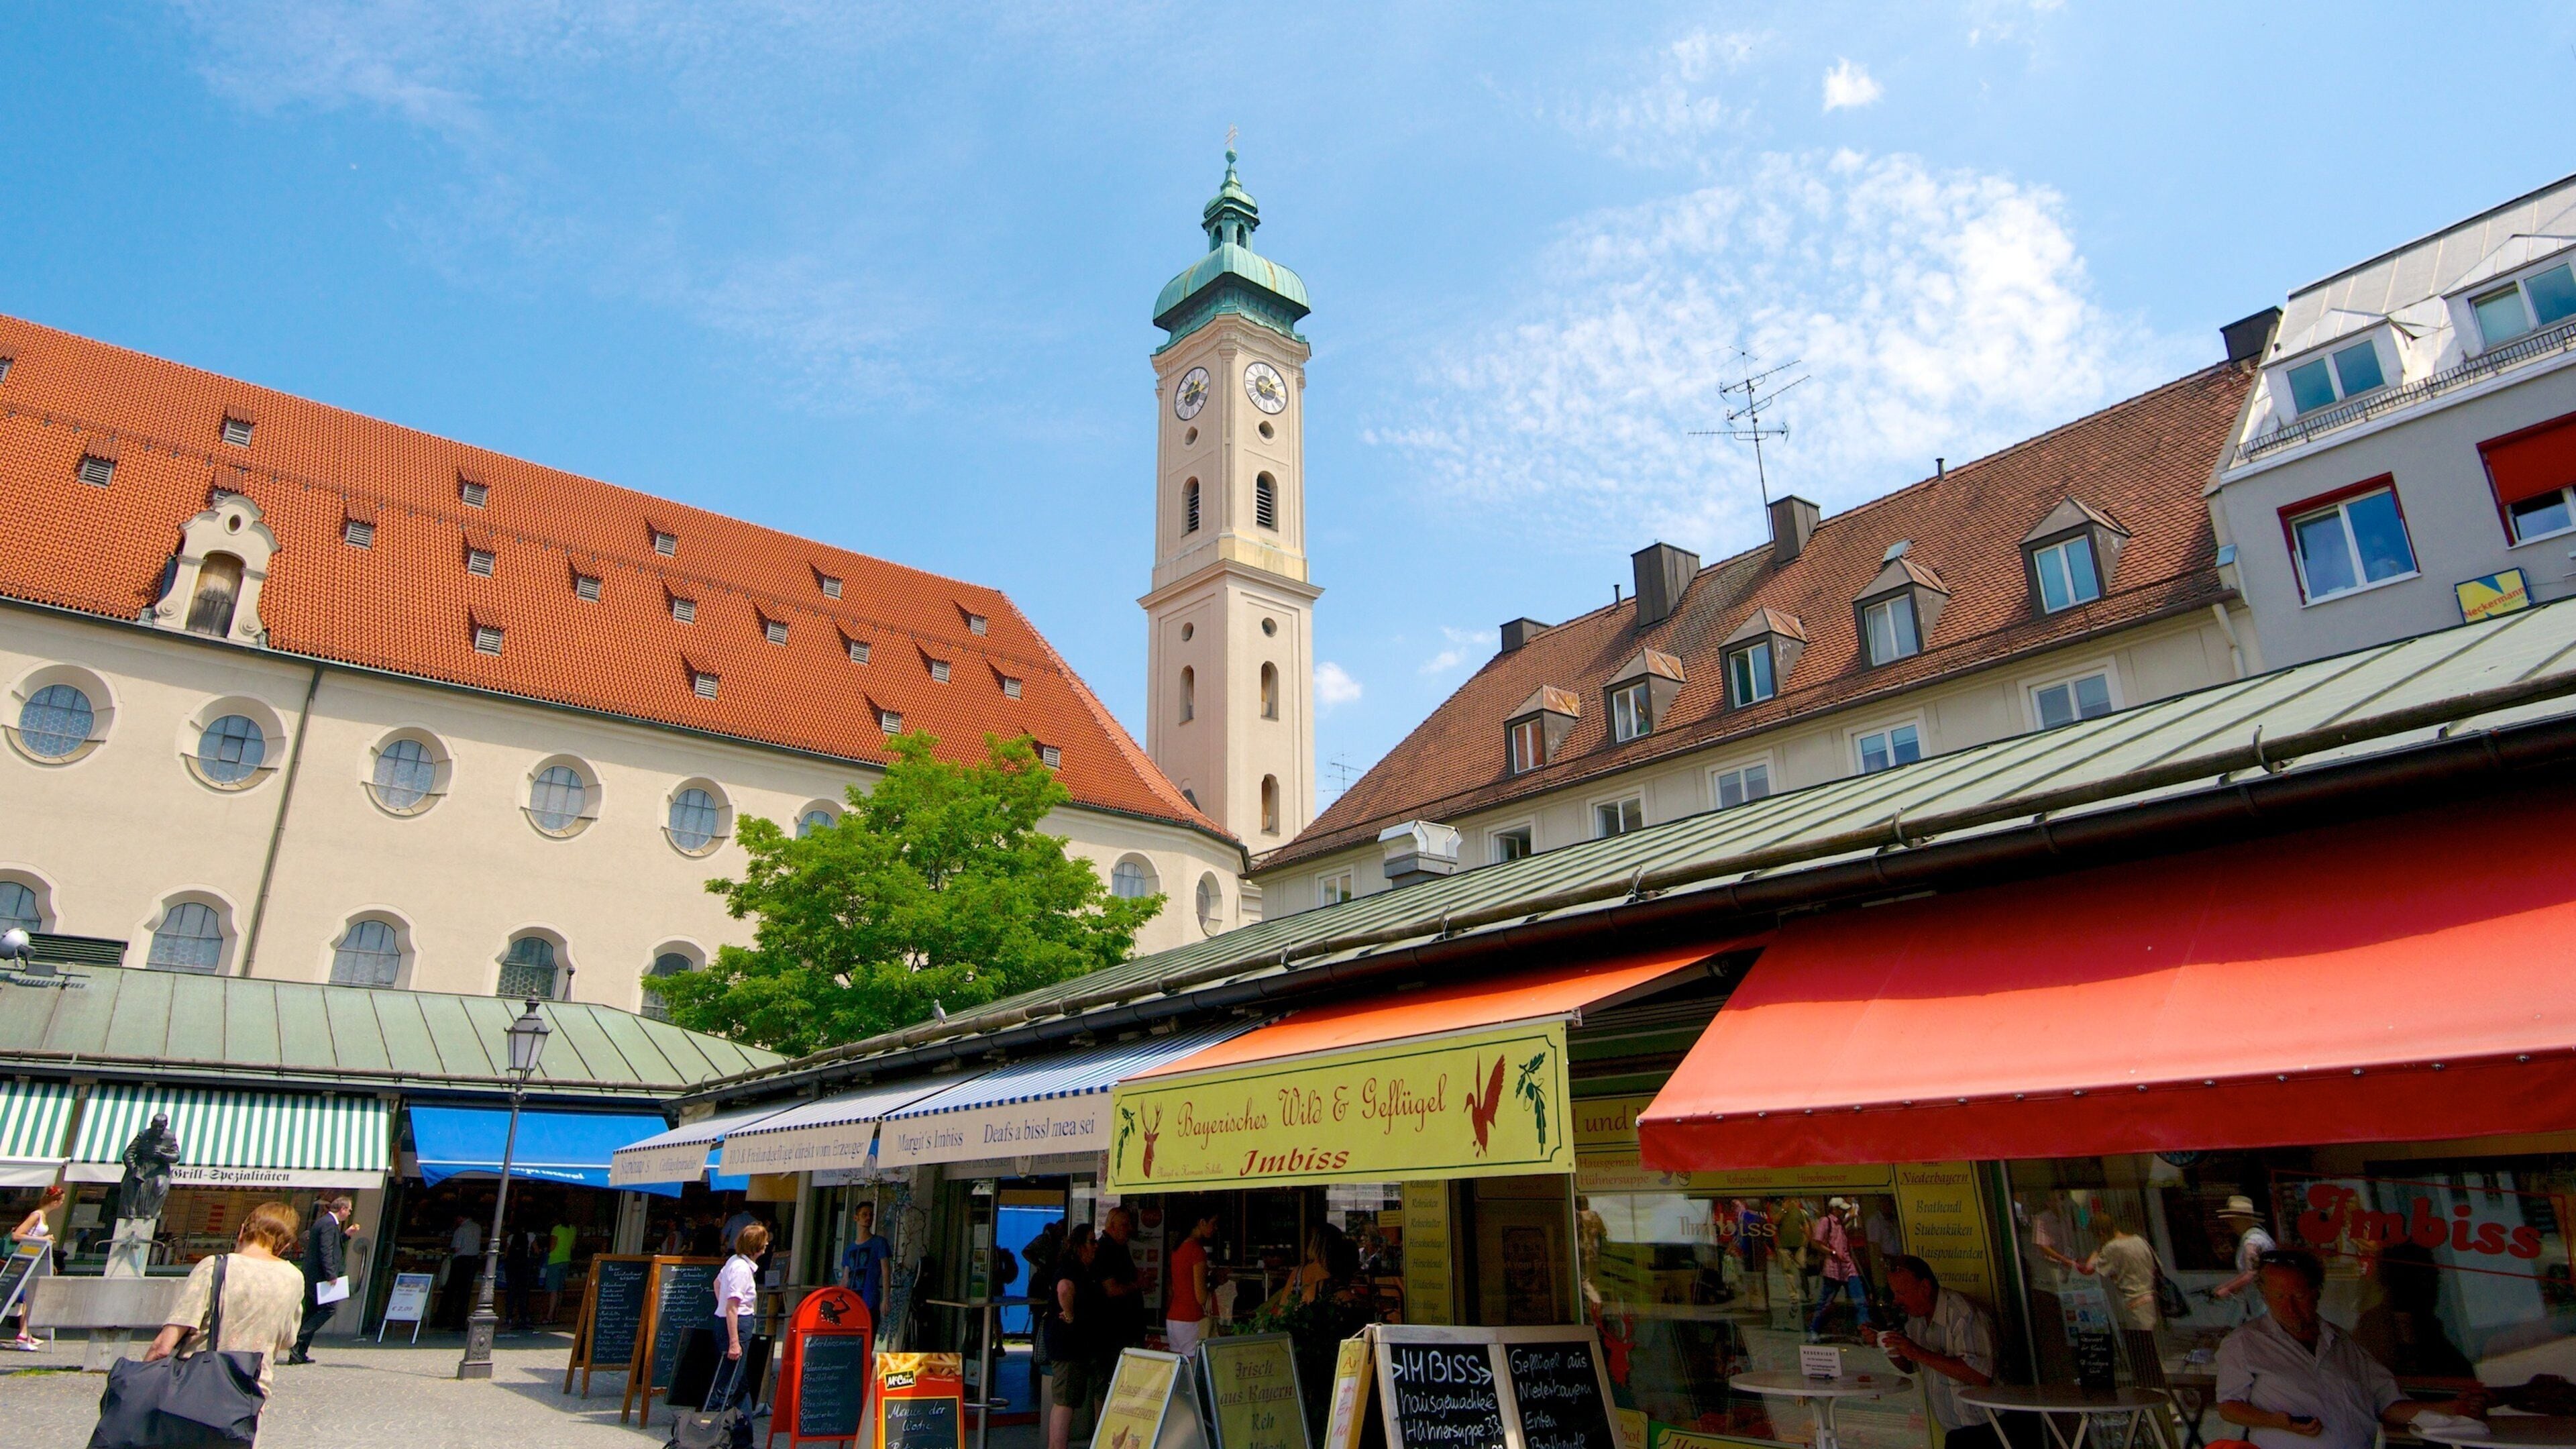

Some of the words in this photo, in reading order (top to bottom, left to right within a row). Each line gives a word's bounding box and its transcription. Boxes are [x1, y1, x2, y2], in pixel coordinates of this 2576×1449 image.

[2463, 587, 2526, 618] Neckermann
[1178, 1097, 1268, 1150] Bayerisches
[1278, 1087, 1322, 1127] Wild
[1333, 1086, 1350, 1122] &
[1362, 1073, 1447, 1135] Geflügel
[1585, 1105, 1629, 1132] und
[934, 1128, 963, 1147] Imbiss
[984, 1122, 1014, 1144] Deafs
[1015, 1129, 1021, 1140] a
[1024, 1118, 1050, 1140] bissl
[1051, 1120, 1076, 1138] mea
[1079, 1112, 1095, 1135] sei
[795, 1142, 814, 1159] direkt
[816, 1145, 832, 1158] vom
[833, 1140, 864, 1159] Erzeuger
[1240, 1147, 1350, 1177] Imbiss
[1580, 1173, 1649, 1186] Hühnersuppe
[1900, 1172, 1969, 1185] Niederbayern
[1915, 1200, 1962, 1214] Brathendl
[1915, 1223, 1973, 1236] Stubenküken
[2298, 1184, 2543, 1259] Imbiss
[1916, 1245, 1984, 1261] Maispoularden
[1235, 1360, 1273, 1378] Frisch
[1402, 1348, 1481, 1384] IMBISS
[1510, 1348, 1560, 1381] Geflügel
[888, 1375, 914, 1387] McCain
[1220, 1391, 1243, 1405] aus
[1248, 1384, 1293, 1403] Bayern
[1486, 1392, 1497, 1409] €
[1519, 1379, 1593, 1405] Niederbayern
[928, 1401, 946, 1415] der
[902, 1419, 932, 1432] Woche
[1252, 1411, 1275, 1430] Reh
[1525, 1410, 1557, 1430] Enten
[1405, 1418, 1485, 1446] Hühnersuppe
